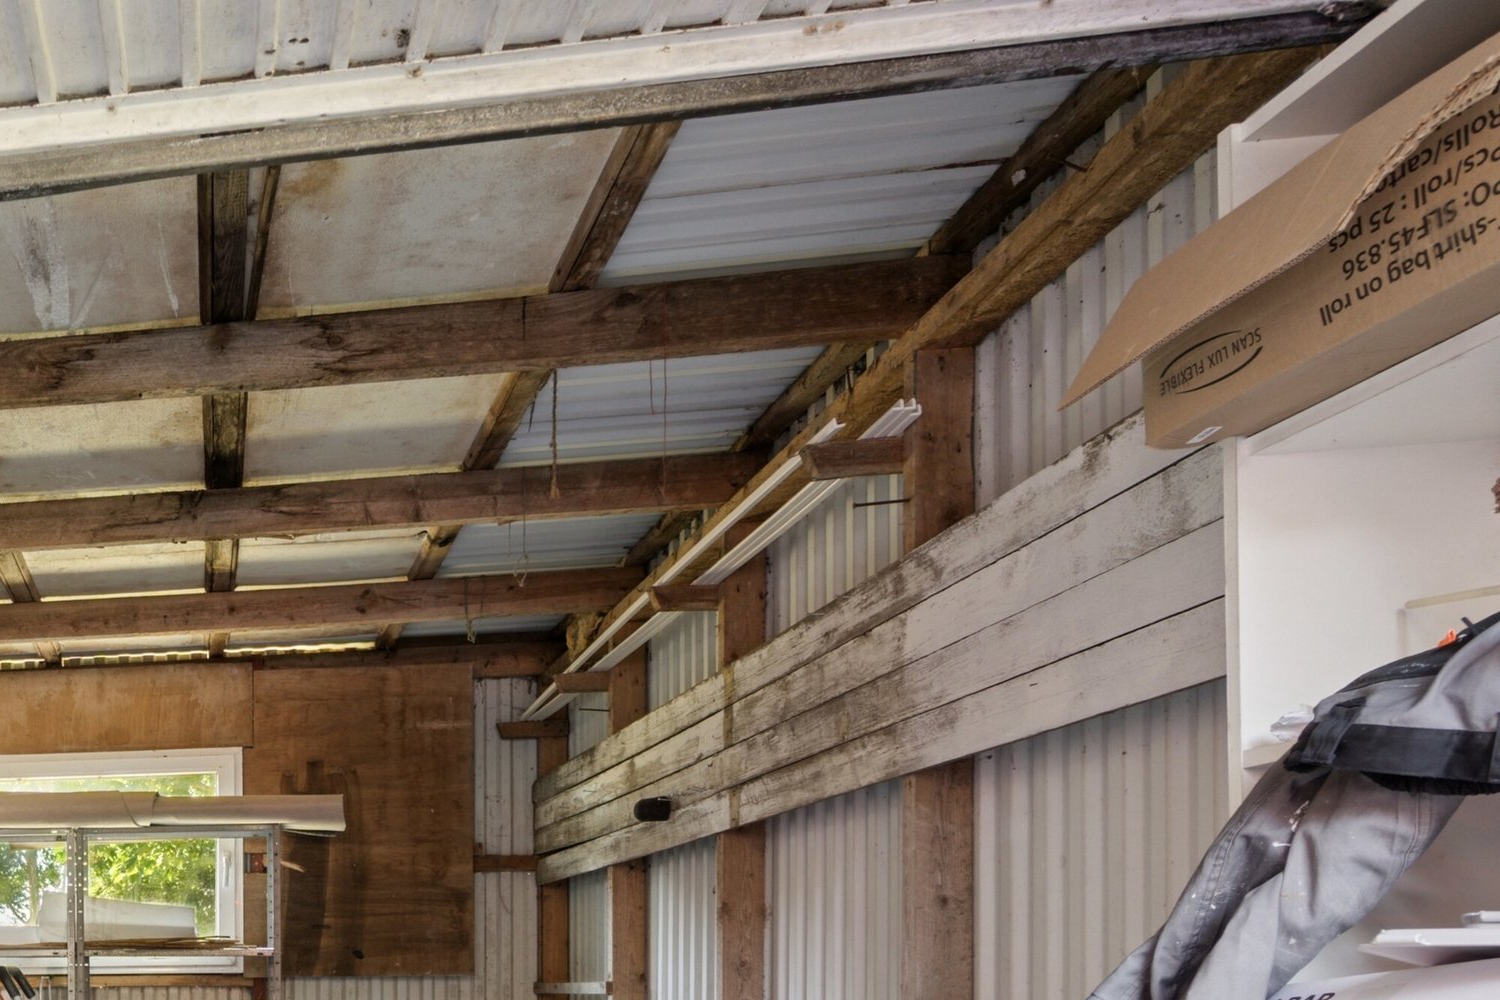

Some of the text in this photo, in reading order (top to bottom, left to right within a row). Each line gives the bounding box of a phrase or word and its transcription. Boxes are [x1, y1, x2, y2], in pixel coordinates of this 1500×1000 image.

[1362, 109, 1500, 203] Rolls/carto
[1328, 214, 1364, 255] pcs
[1341, 198, 1458, 281] SLF45.836
[1369, 200, 1396, 232] 25
[1318, 216, 1500, 327] -shirt bag on roll
[1158, 328, 1262, 397] SCAN LUX FLEXIBLE
